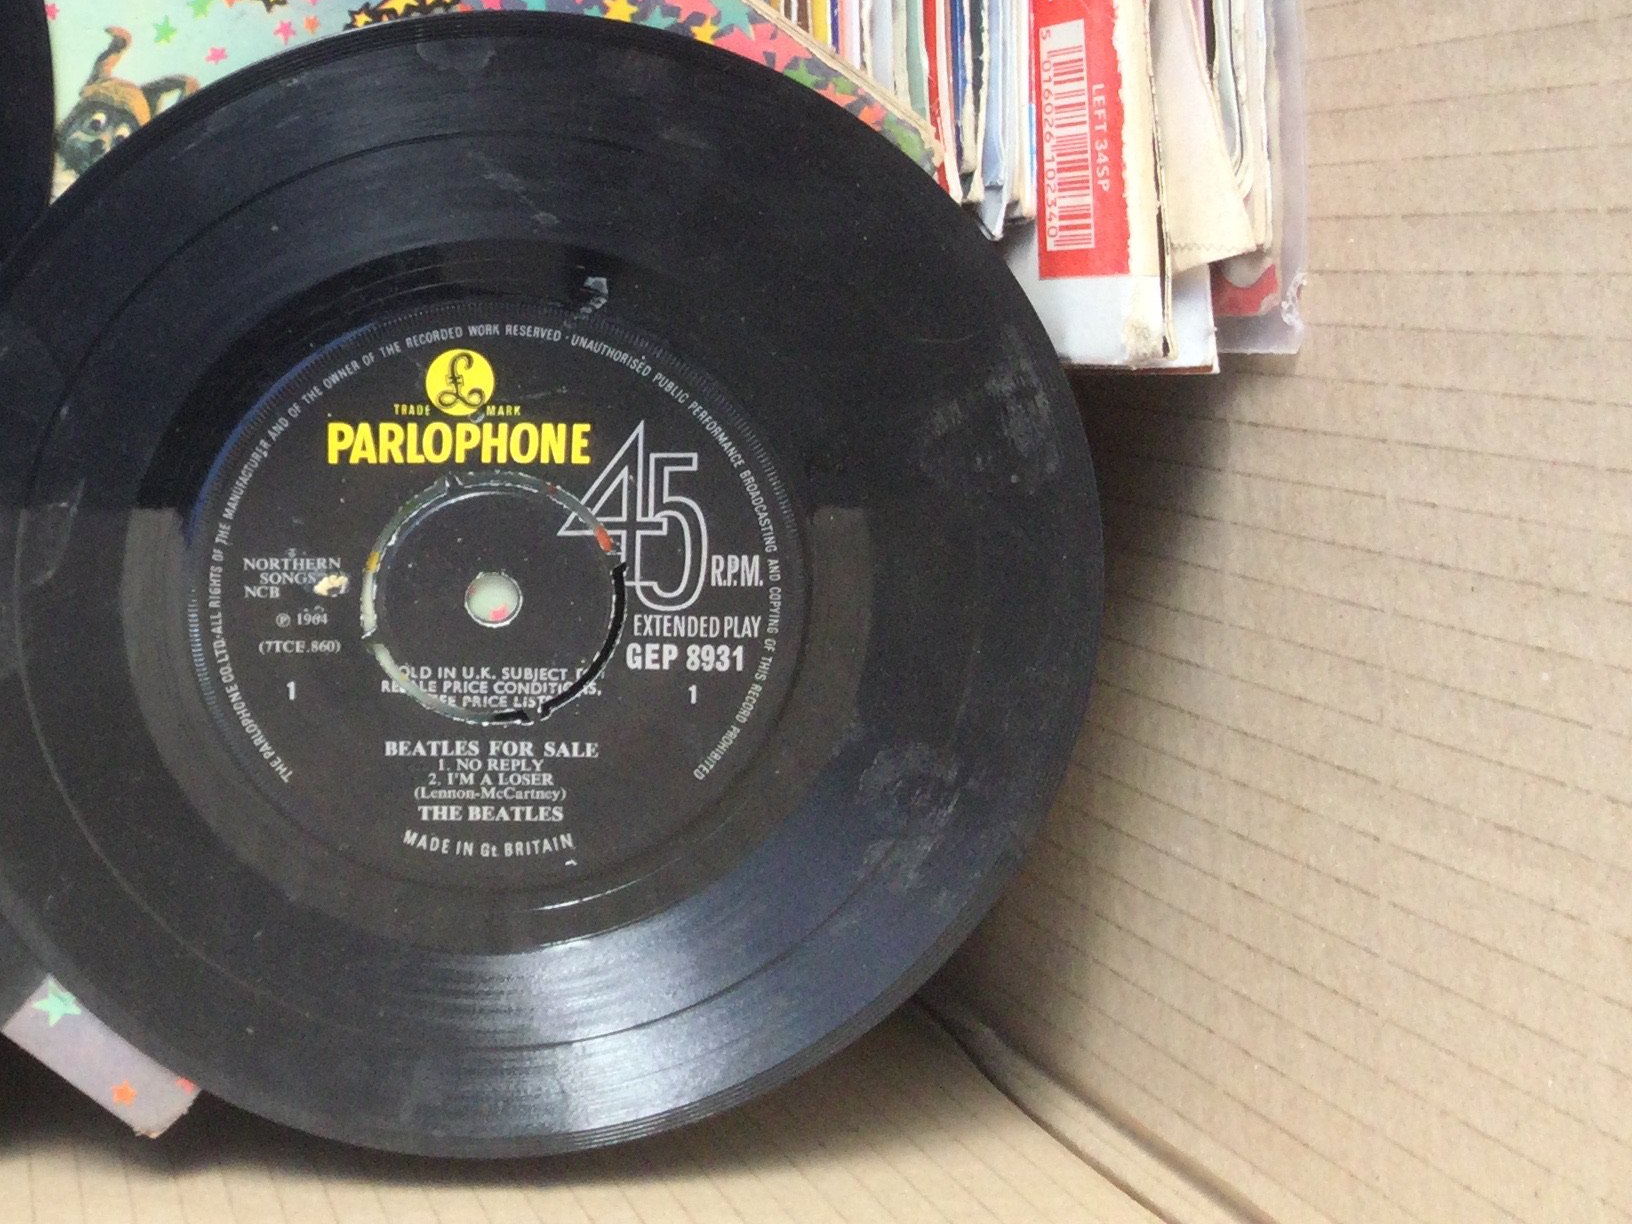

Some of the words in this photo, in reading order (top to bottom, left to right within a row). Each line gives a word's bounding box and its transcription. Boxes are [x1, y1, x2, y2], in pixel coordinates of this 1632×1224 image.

[1042, 59, 1055, 143] 016026
[1091, 82, 1107, 134] LEFT
[1094, 139, 1111, 192] 34SP
[1046, 155, 1059, 239] 102340
[405, 326, 464, 348] RECORDED
[467, 323, 500, 337] WORK
[505, 323, 562, 342] RESERVED
[361, 351, 375, 367] OF
[378, 341, 402, 358] THE
[570, 333, 652, 377] UNAUTHORISED
[322, 360, 361, 390] OWNER
[301, 385, 324, 405] THE
[652, 372, 690, 404] PUBLIC
[287, 402, 302, 419] OF
[394, 404, 431, 416] TRADE
[486, 405, 522, 417] MARK
[267, 416, 290, 442] AND
[687, 400, 746, 469] PERFORMANCE
[327, 421, 592, 465] PARLOPHONE
[222, 438, 271, 520] MANUFACTURER
[556, 419, 709, 612] 45
[739, 469, 778, 554] BROADCASTING
[214, 522, 231, 546] THE
[211, 548, 224, 562] OF
[243, 557, 341, 573] NORTHERN
[260, 572, 318, 587] SONGS
[710, 555, 764, 588] R.P.M.
[767, 558, 782, 582] AND
[208, 565, 223, 609] RIGHTS
[244, 586, 280, 600] NCB
[296, 613, 328, 627] 1964
[766, 586, 782, 634] COPYING
[633, 614, 720, 638] EXTENDED
[722, 615, 762, 639] PLAY
[763, 637, 777, 652] OF
[626, 643, 679, 670] GEP
[686, 644, 744, 672] 8931
[754, 656, 773, 682] THIS
[398, 666, 435, 681] OLD
[438, 666, 457, 680] IN
[462, 666, 496, 681] U.K.
[501, 667, 568, 683] SUBJECT
[286, 680, 296, 701] 1
[443, 681, 489, 694] PRICE
[687, 684, 698, 705] 1
[463, 696, 508, 709] PRICE
[735, 683, 763, 724] RECORD
[225, 683, 276, 760] PARLOPHONE
[384, 740, 480, 757] BEATLES
[489, 741, 534, 757] FOR
[543, 742, 599, 759] SALE
[693, 724, 741, 781] PROHIBITED
[269, 755, 294, 784] THE
[438, 759, 450, 772] 1.
[456, 759, 482, 772] NO
[488, 759, 545, 772] REPLY
[447, 773, 474, 787] I'M
[480, 774, 493, 787] A
[498, 773, 554, 787] LOSER
[418, 805, 463, 821] THE
[468, 805, 565, 822] BEATLES
[402, 830, 449, 854] MADE
[456, 841, 474, 856] IN
[504, 833, 574, 857] BRITAIN
